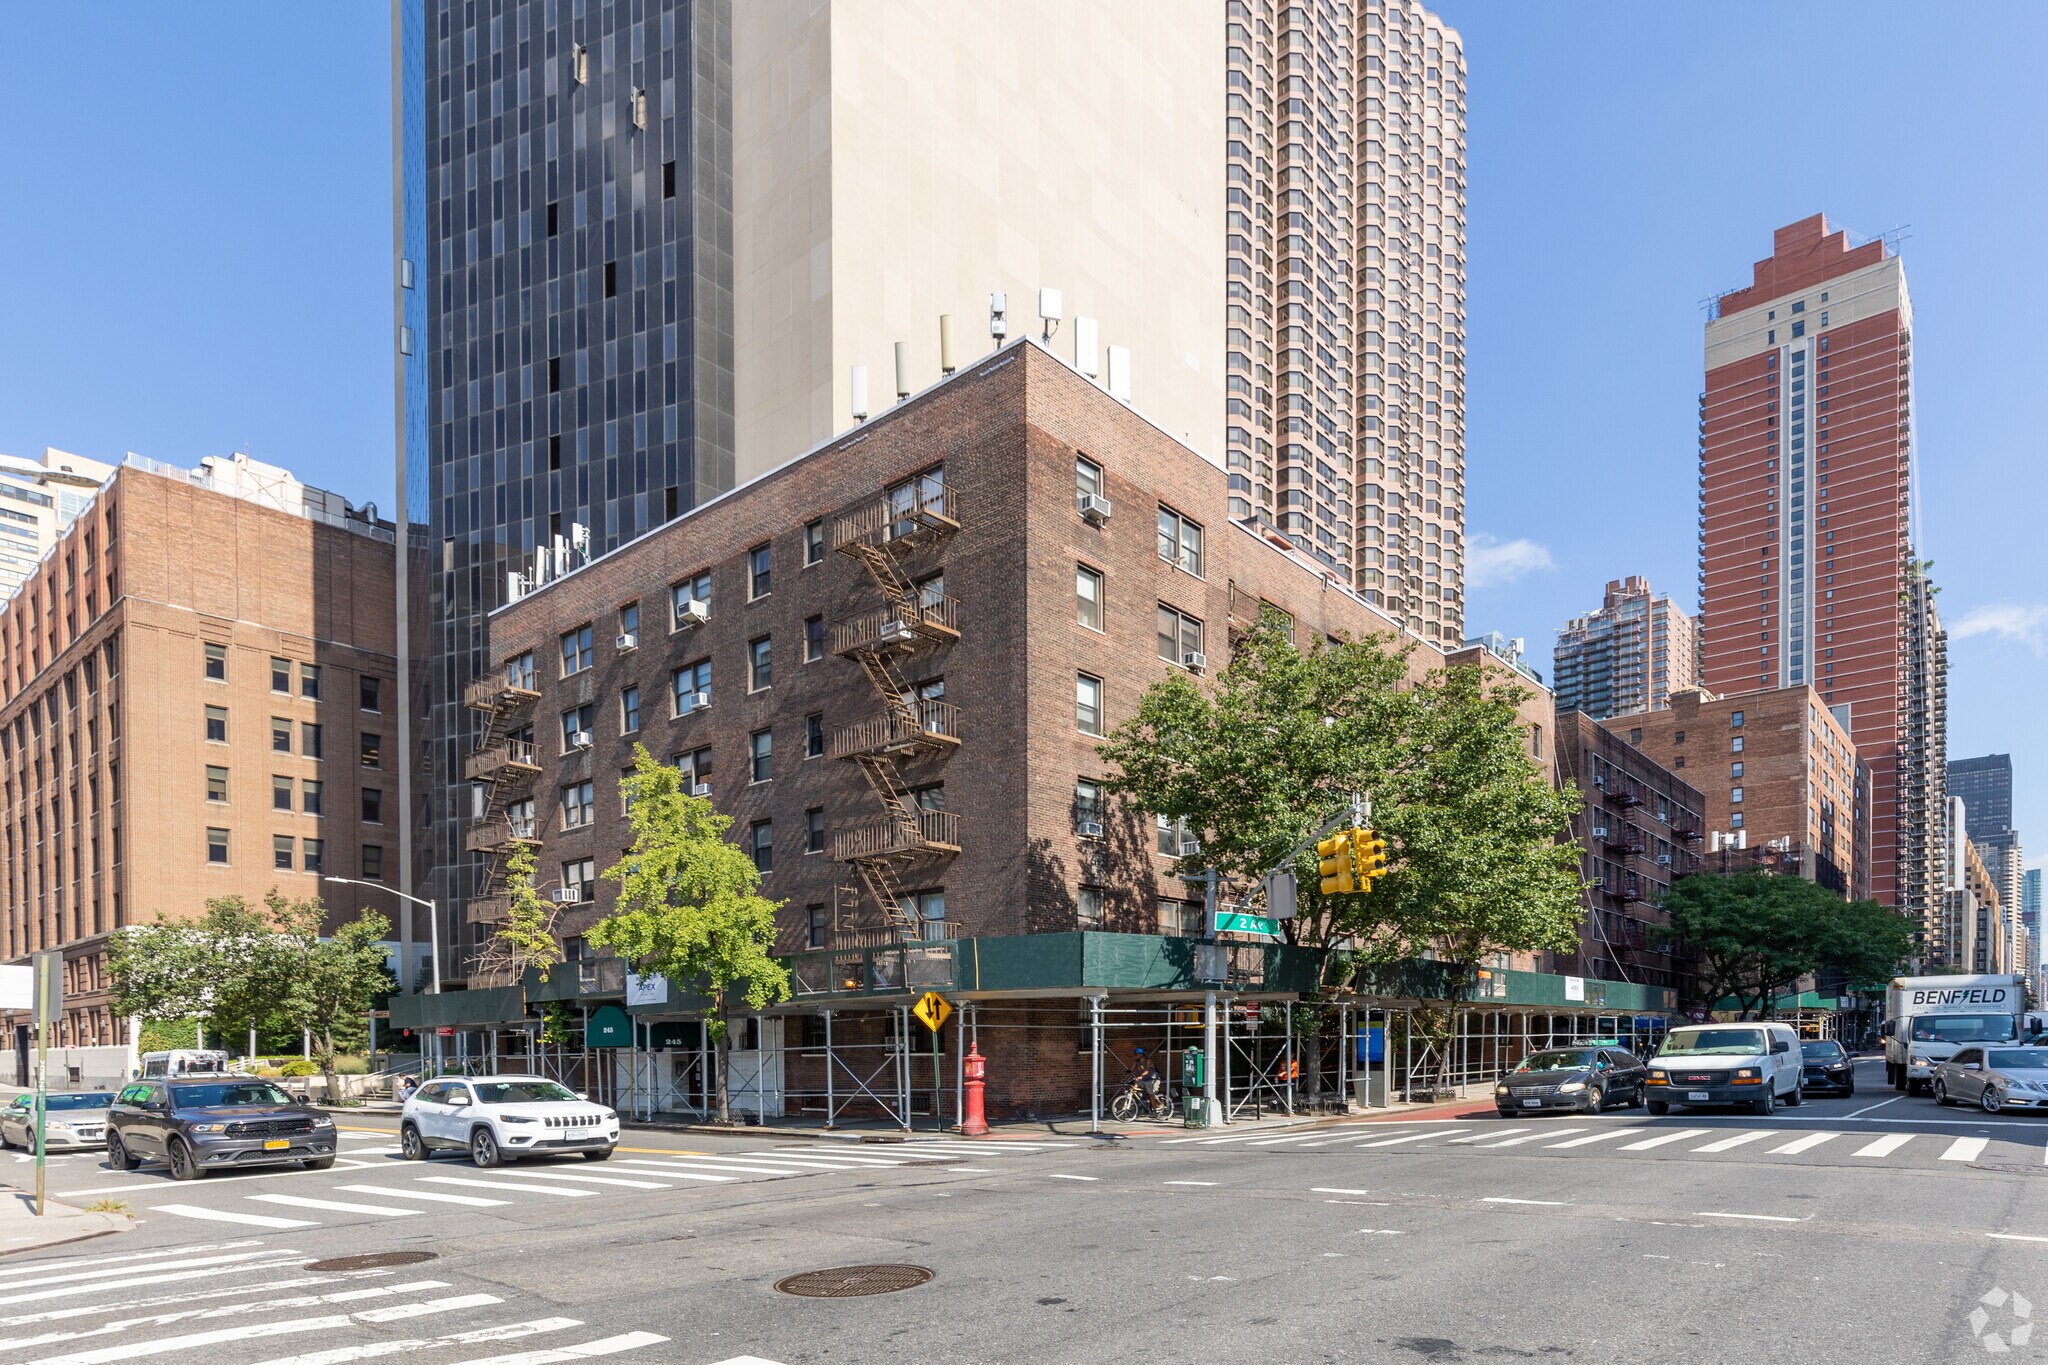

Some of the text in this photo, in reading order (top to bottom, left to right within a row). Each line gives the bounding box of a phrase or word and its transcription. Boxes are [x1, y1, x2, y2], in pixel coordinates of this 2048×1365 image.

[1240, 918, 1247, 929] 2
[638, 983, 656, 991] APEX
[1912, 989, 2006, 1005] BENFIELD
